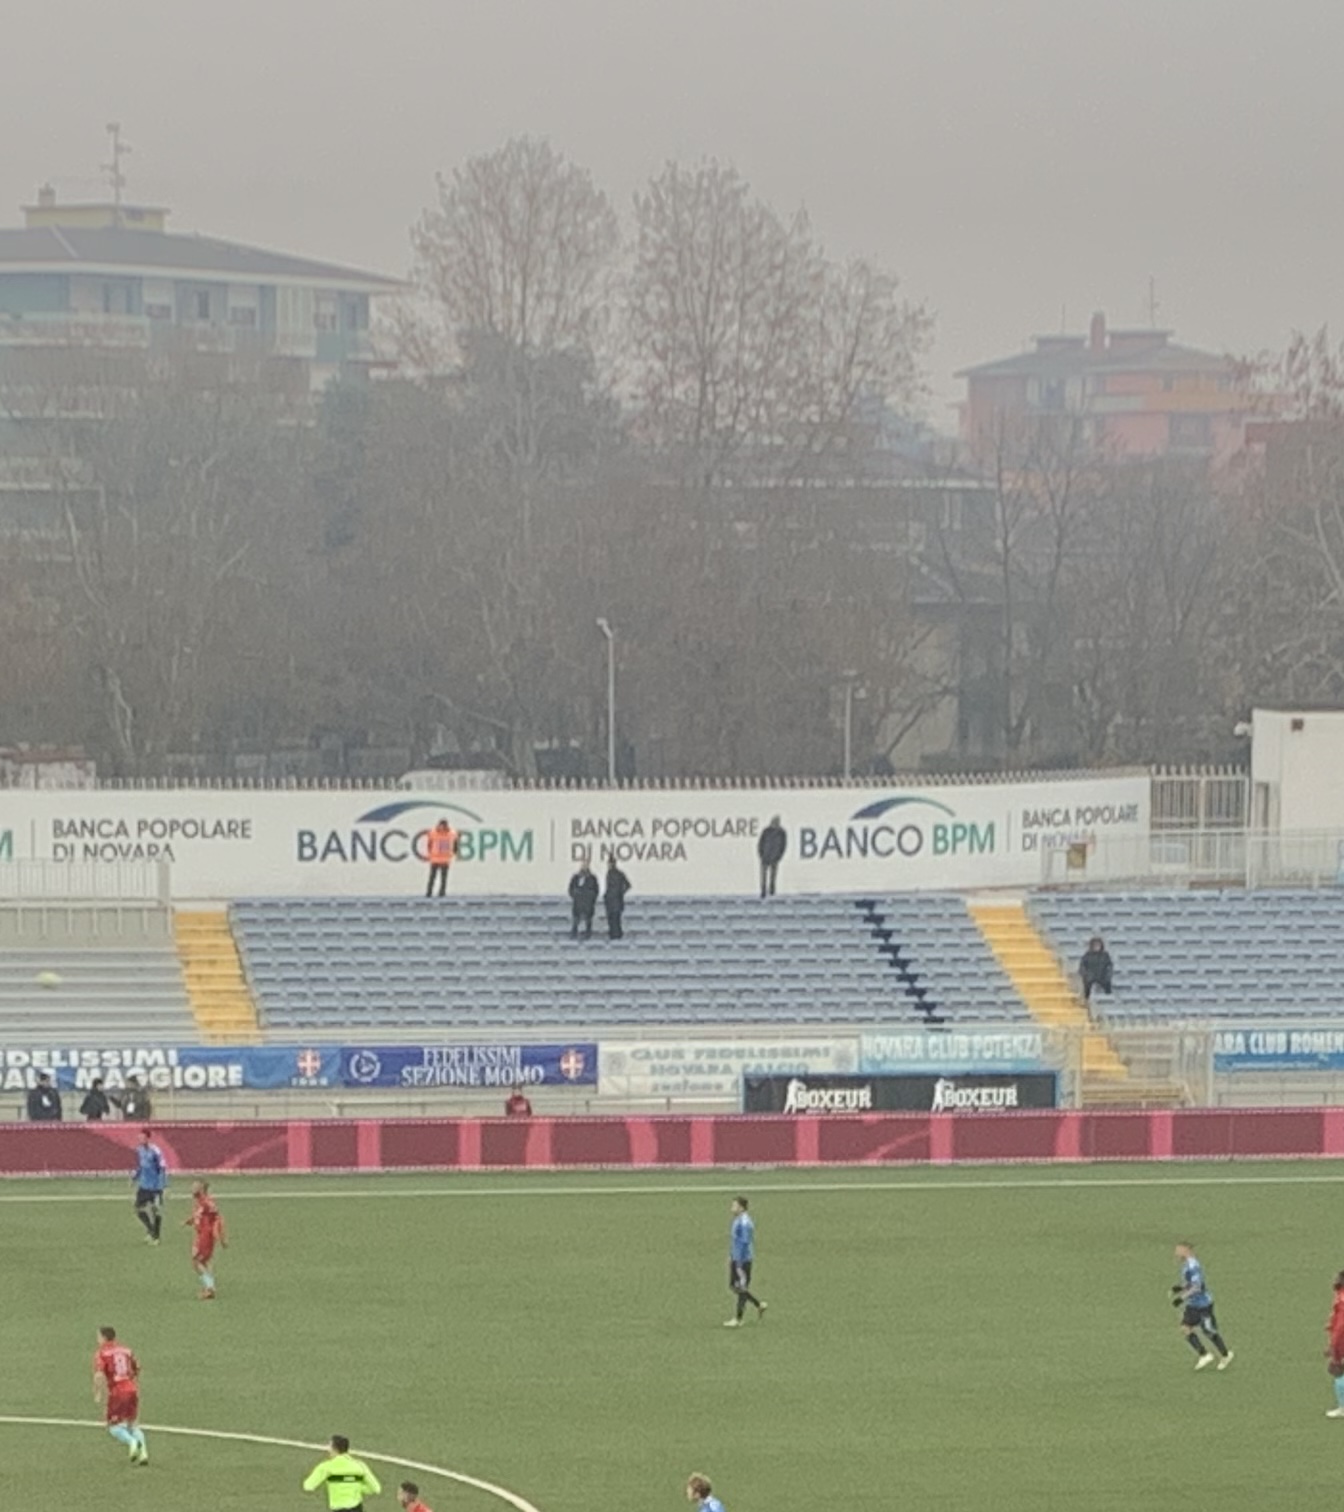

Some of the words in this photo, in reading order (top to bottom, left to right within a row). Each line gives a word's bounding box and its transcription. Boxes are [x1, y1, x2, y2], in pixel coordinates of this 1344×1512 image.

[571, 818, 643, 838] BANCA
[652, 817, 759, 837] POPOLARE
[1022, 807, 1071, 828] BANCA
[1076, 804, 1139, 825] POPOLARE
[53, 818, 128, 840] BANCA
[137, 817, 252, 840] POPOLARE
[456, 829, 533, 862] BPM
[571, 843, 592, 862] DI
[601, 843, 687, 862] NOVARA
[799, 825, 924, 859] BANCO
[932, 823, 995, 855] BPM
[1022, 833, 1037, 852] DI
[53, 844, 74, 863] DI
[83, 843, 175, 863] NOVARA
[928, 1034, 969, 1060] CLUB
[1250, 1031, 1287, 1054] CLUB
[423, 1046, 522, 1066] FEDELISSIMI
[401, 1066, 480, 1087] SEZIONE
[484, 1066, 544, 1086] MOMO
[797, 1084, 872, 1109] BOXEUR
[943, 1083, 1019, 1108] BOXEUR
